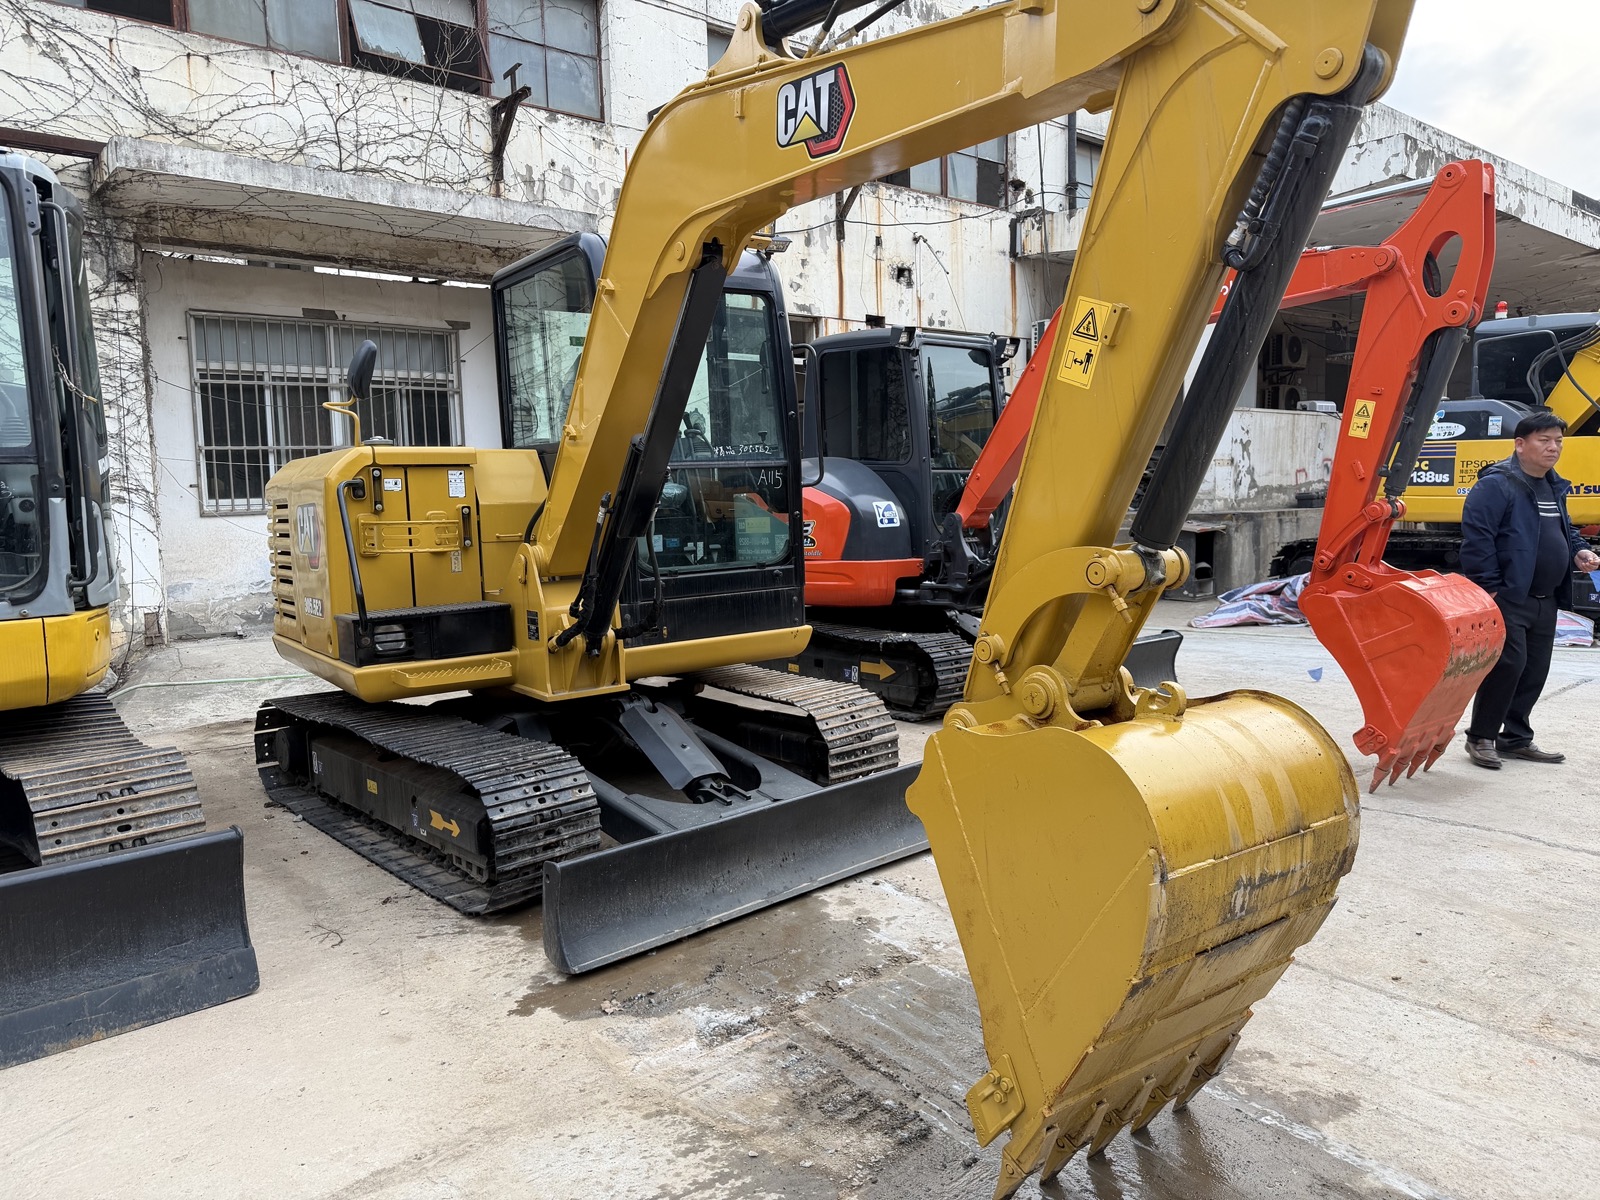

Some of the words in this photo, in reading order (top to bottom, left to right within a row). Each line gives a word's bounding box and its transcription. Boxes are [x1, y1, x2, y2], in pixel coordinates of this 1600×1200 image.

[777, 69, 835, 146] CAT
[757, 469, 783, 489] A115
[297, 506, 315, 553] CAT
